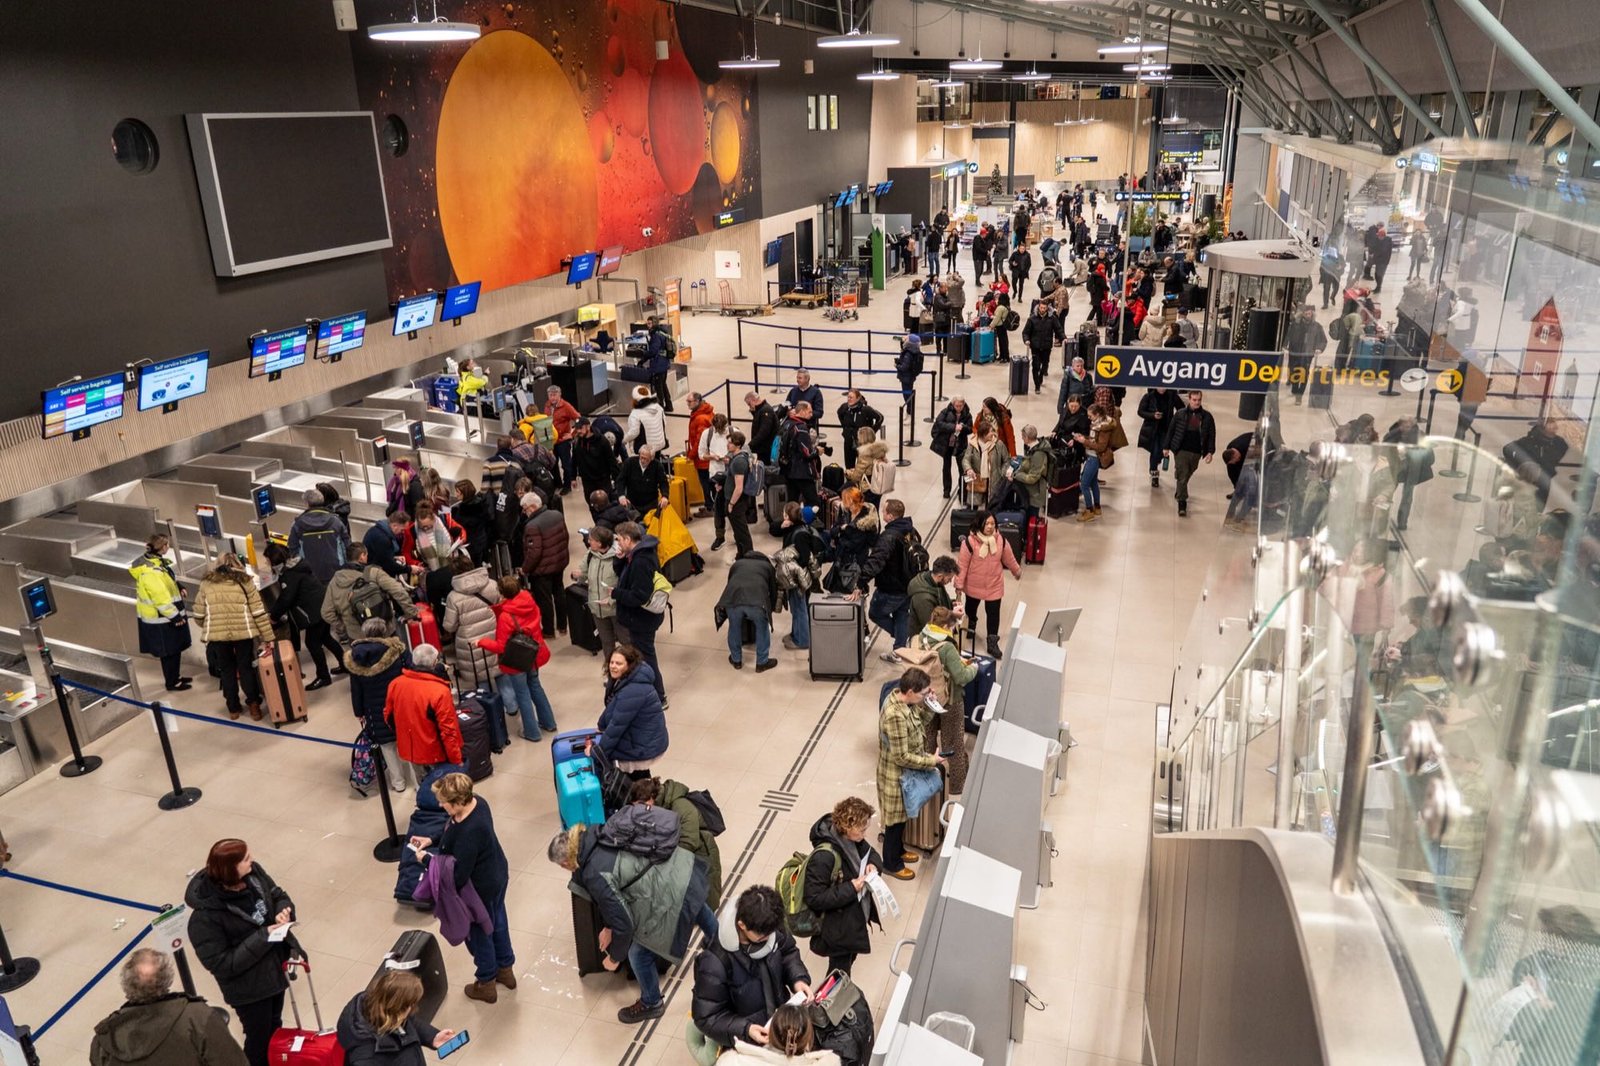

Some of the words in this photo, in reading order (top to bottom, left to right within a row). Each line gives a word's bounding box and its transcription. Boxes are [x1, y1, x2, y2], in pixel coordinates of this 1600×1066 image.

[180, 357, 198, 365] bagdrop
[1129, 355, 1228, 384] Avgang
[1238, 358, 1389, 388] Departures
[72, 384, 89, 393] service
[90, 379, 112, 388] bagdrop
